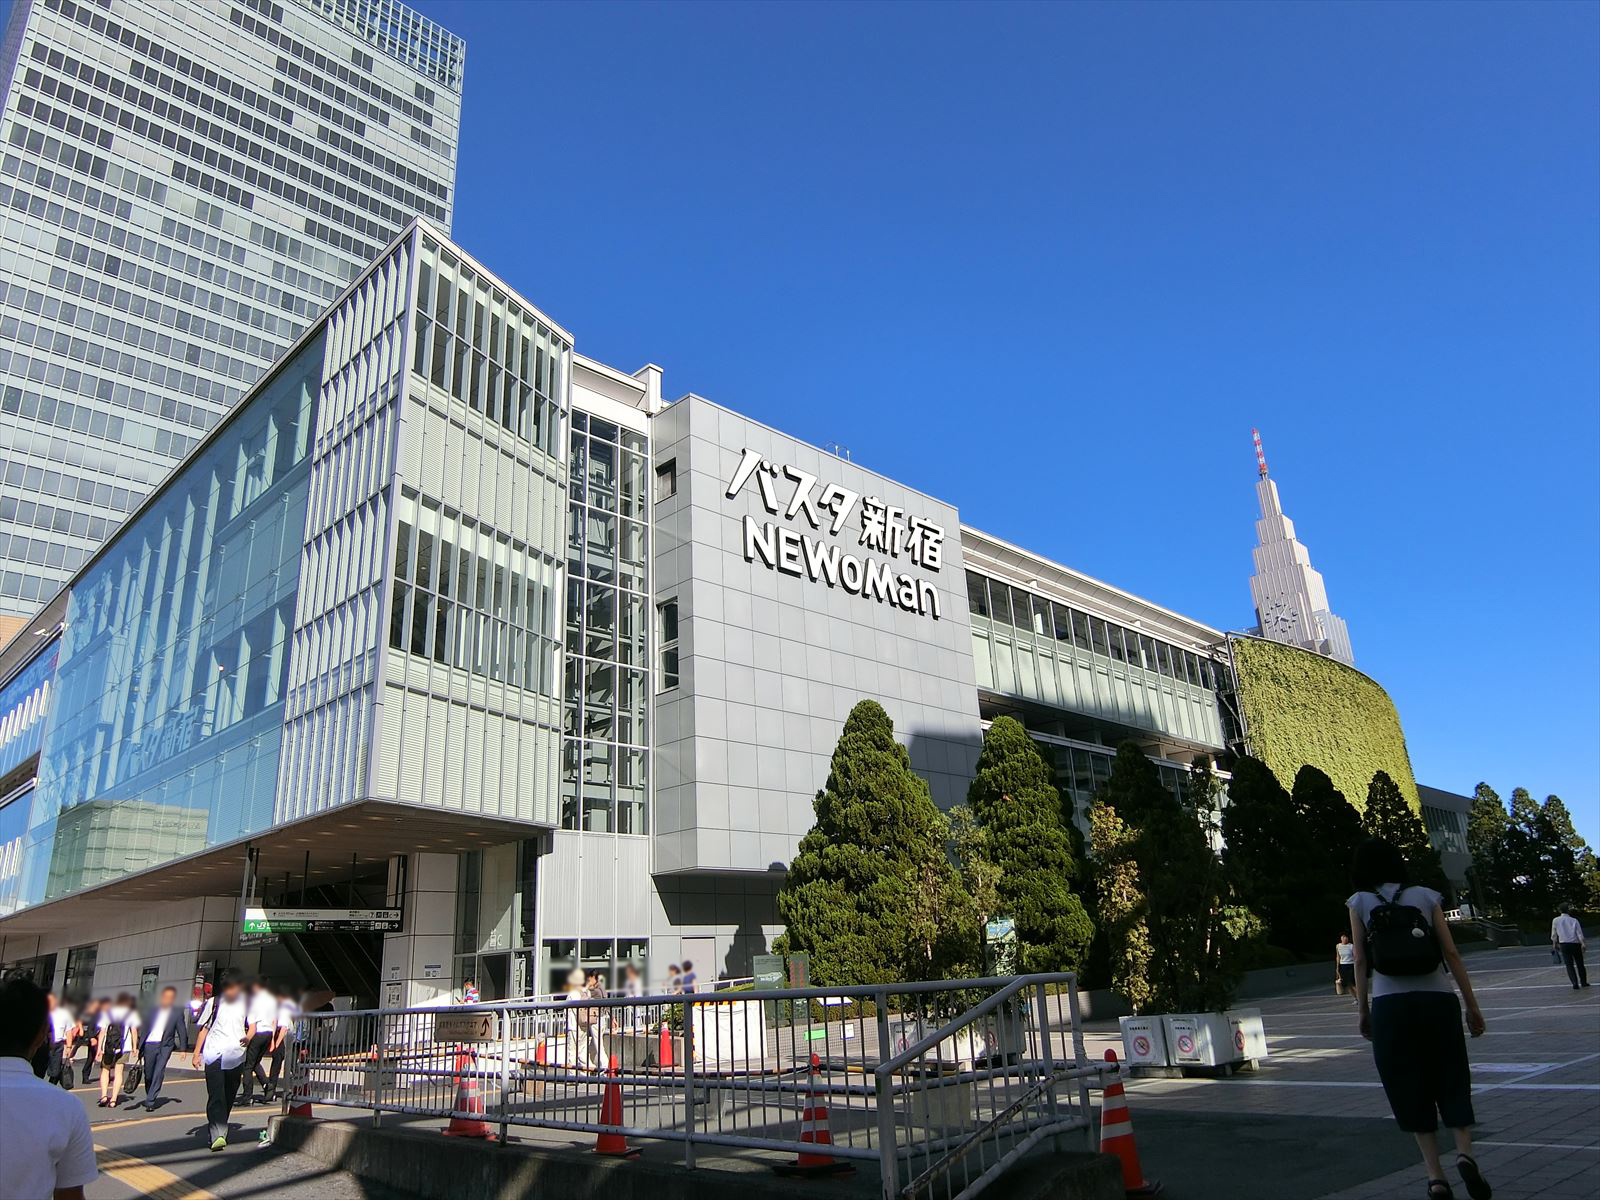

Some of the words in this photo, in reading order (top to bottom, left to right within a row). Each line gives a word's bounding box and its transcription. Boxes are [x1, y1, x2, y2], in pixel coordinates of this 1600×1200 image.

[725, 447, 945, 572] バスタ新宿
[256, 921, 267, 930] JR
